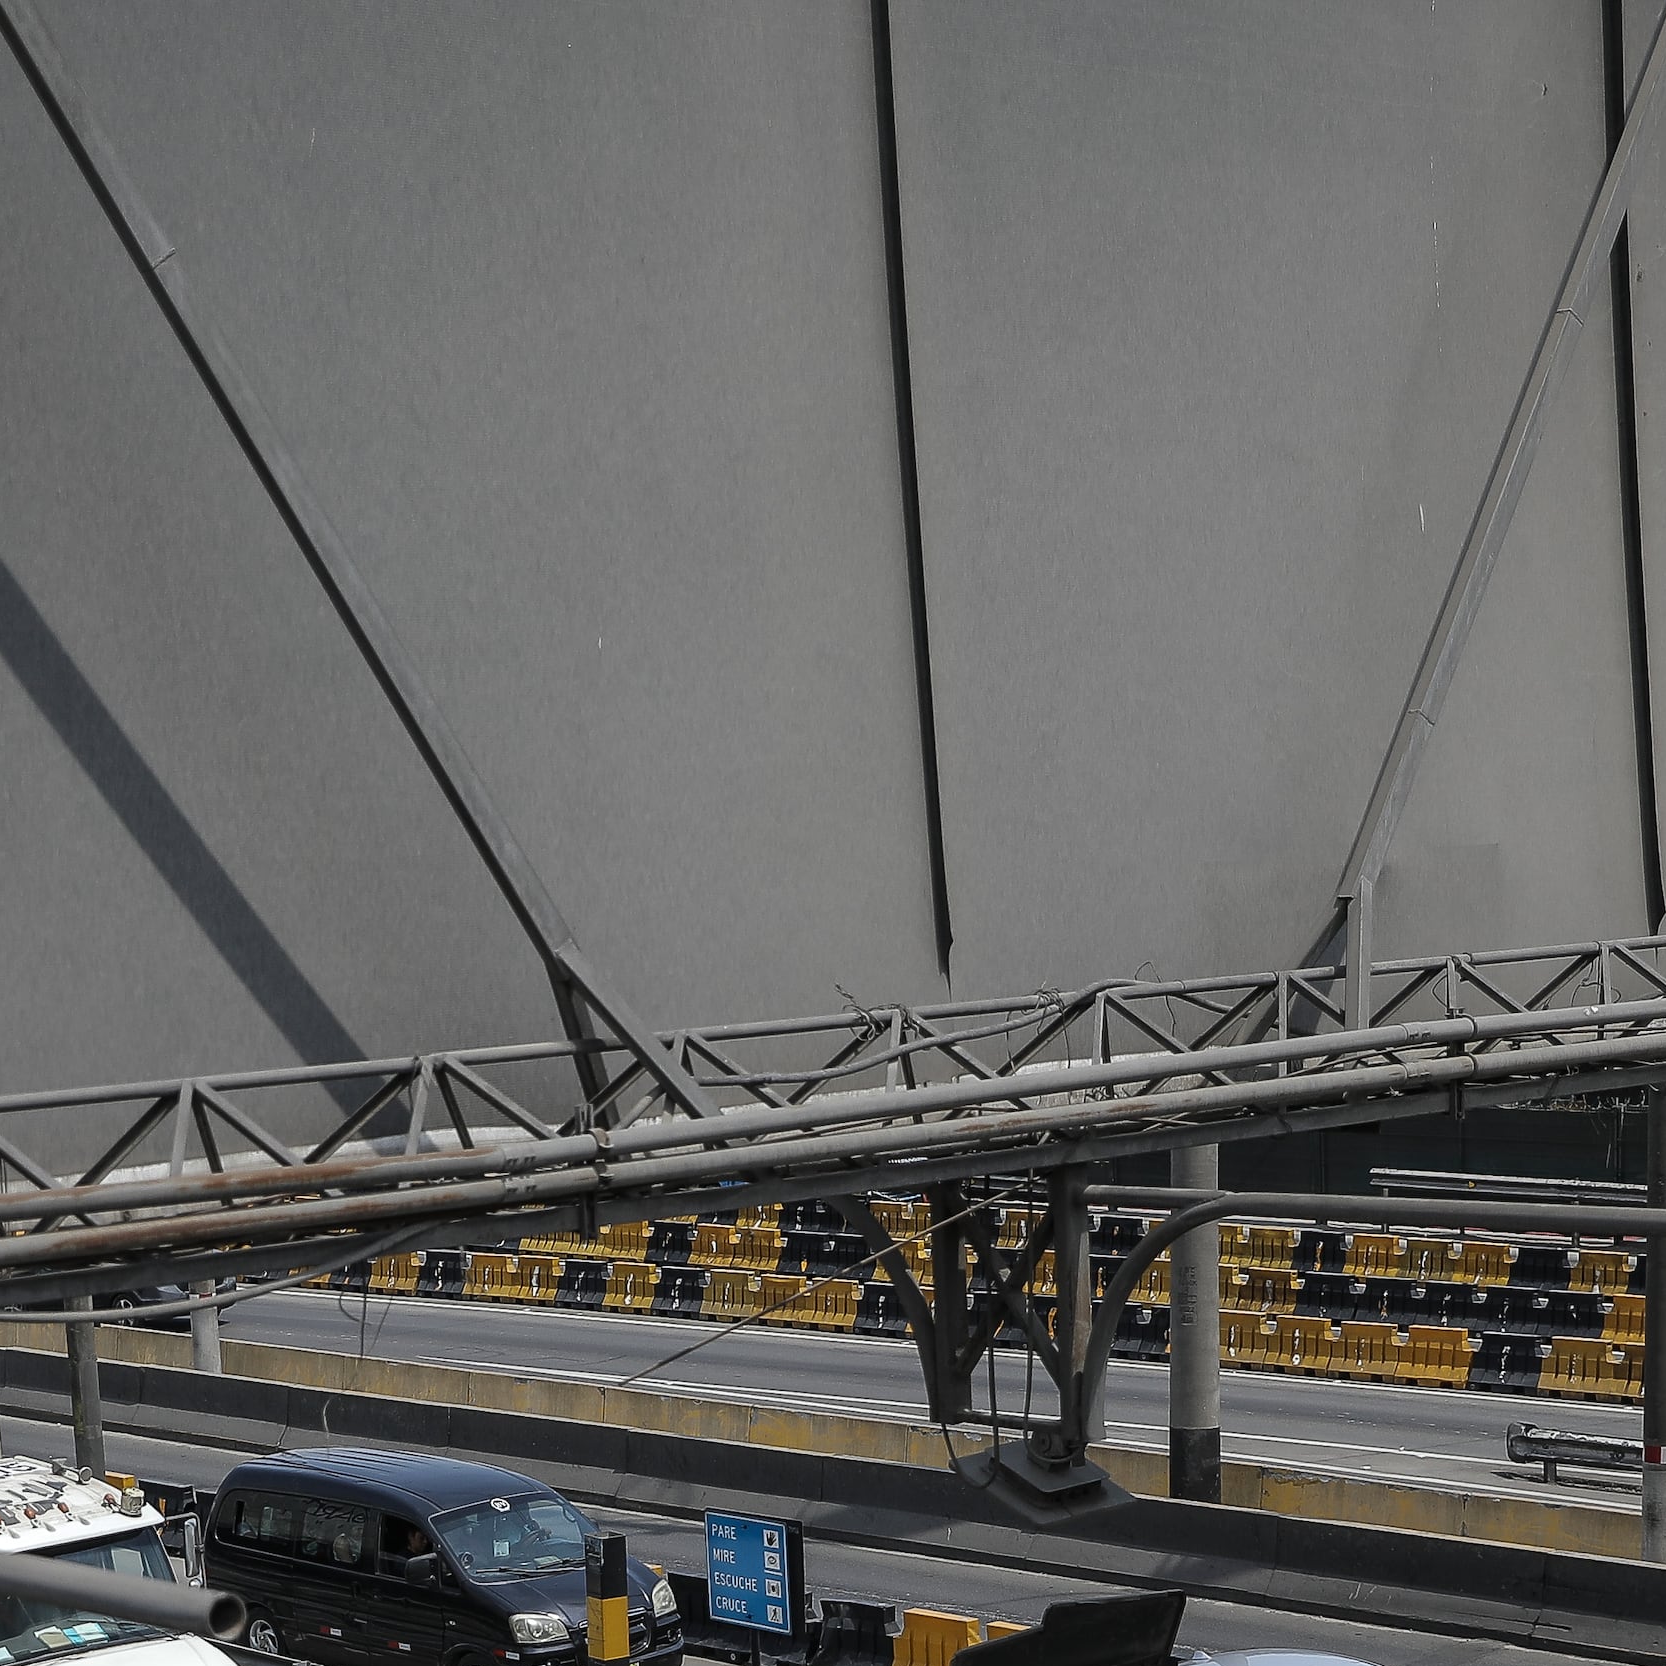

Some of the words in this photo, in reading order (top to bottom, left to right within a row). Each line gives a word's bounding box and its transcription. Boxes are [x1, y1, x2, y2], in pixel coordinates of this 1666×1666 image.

[712, 1523, 737, 1540] PARE
[713, 1548, 736, 1564] MIRE
[714, 1571, 758, 1592] ESCUCHE
[715, 1595, 748, 1614] CRUCE
